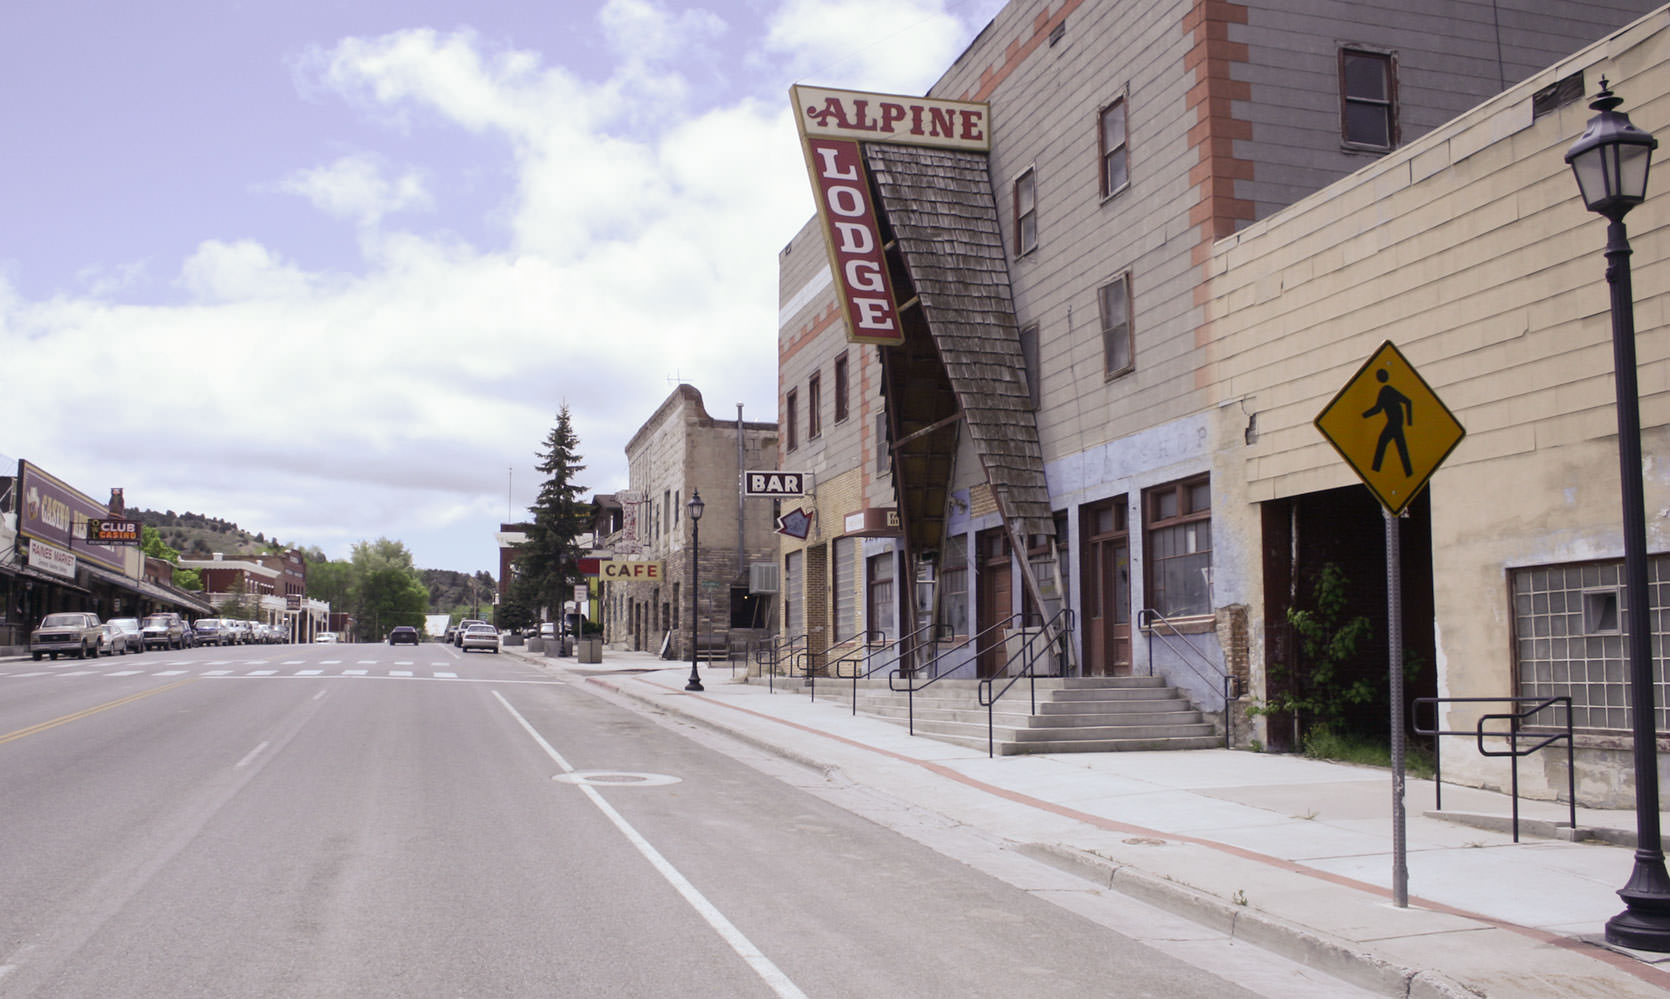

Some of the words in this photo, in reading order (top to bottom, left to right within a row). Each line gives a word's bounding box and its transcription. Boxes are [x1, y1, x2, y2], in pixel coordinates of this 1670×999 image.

[806, 97, 984, 141] ALPINE
[816, 147, 894, 330] LODGE
[751, 474, 799, 493] BAR
[41, 494, 70, 533] CASINO
[98, 531, 137, 540] CASINO
[100, 522, 136, 532] CLUB
[605, 564, 658, 577] CAFE
